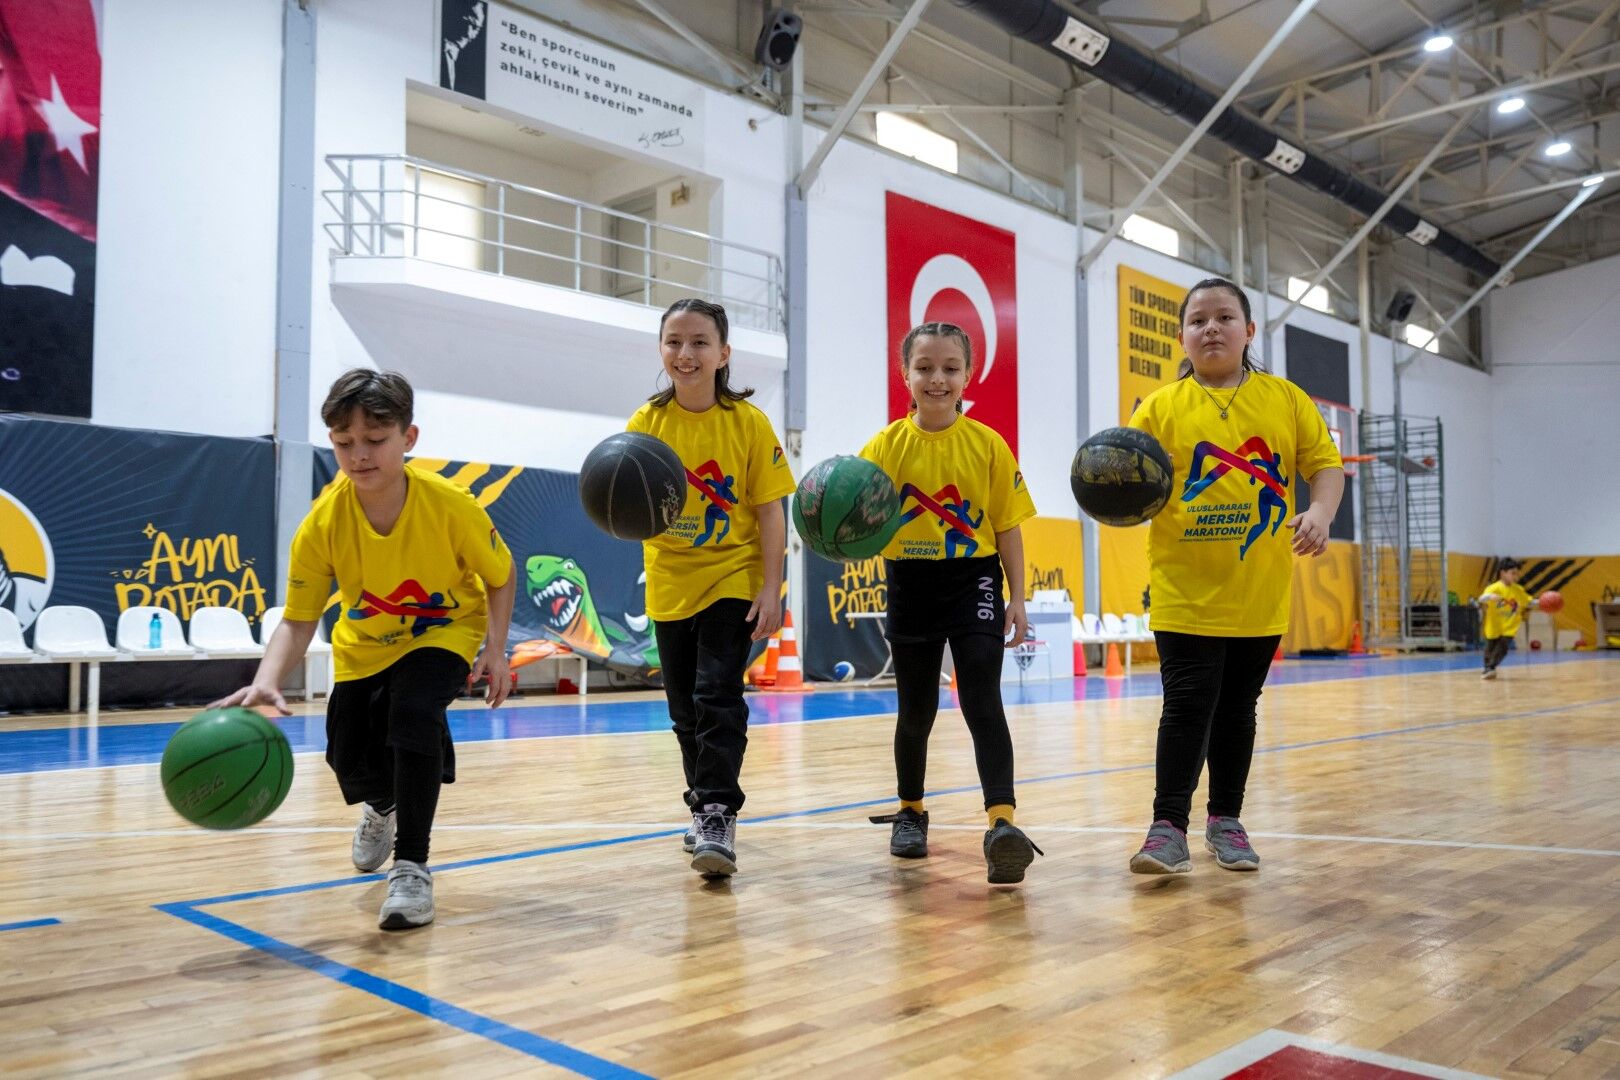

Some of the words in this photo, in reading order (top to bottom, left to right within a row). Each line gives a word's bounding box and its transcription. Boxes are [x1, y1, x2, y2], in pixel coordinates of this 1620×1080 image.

[542, 38, 616, 72] sporcunun
[500, 61, 580, 96] ahlaklısını
[500, 42, 537, 64] zeki,
[542, 57, 581, 78] çevik
[585, 72, 600, 85] ve
[604, 79, 633, 97] aynı
[637, 91, 694, 118] zamanda
[1187, 503, 1252, 512] ULUSLARARASI
[1196, 511, 1251, 525] MERSİN
[1184, 526, 1247, 537] MARATONU
